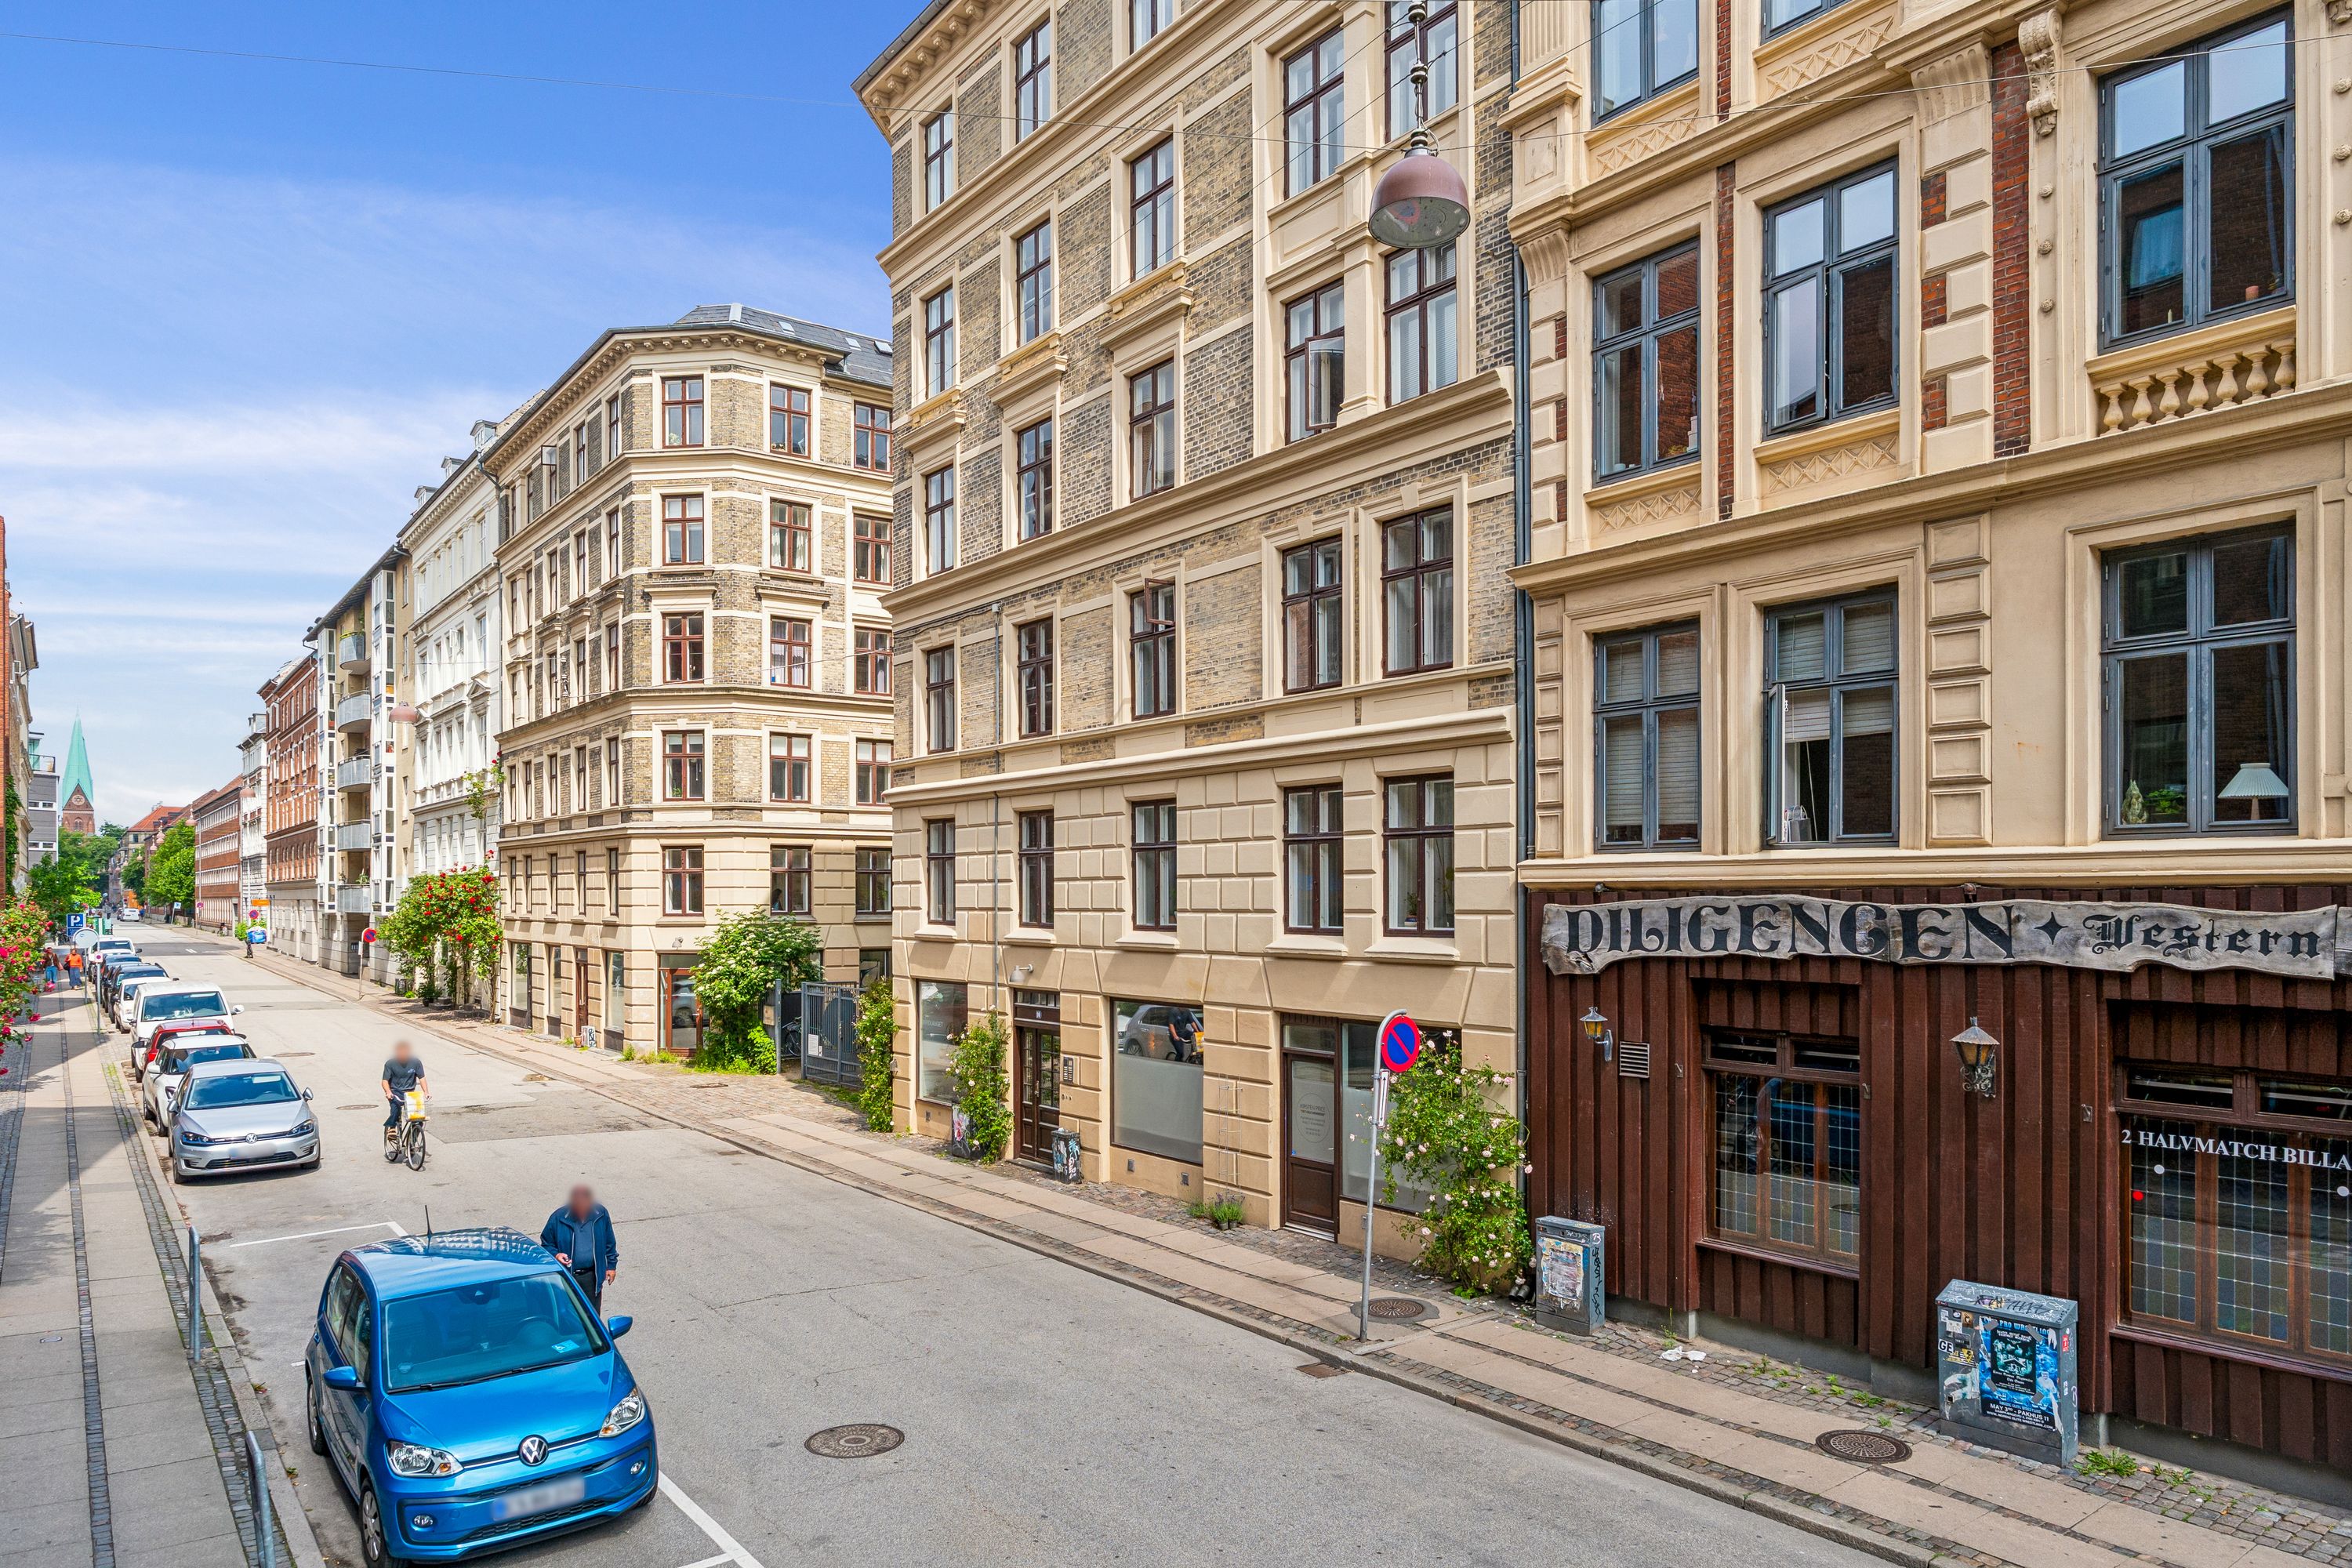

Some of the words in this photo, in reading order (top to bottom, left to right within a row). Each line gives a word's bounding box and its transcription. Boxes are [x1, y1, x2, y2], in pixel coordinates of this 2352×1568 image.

[2122, 1129, 2132, 1144] 2
[2138, 1130, 2277, 1161] HALVMATCH
[2281, 1147, 2352, 1171] BILLA
[1939, 1340, 1953, 1353] GE
[2017, 1410, 2043, 1421] PAKHUS
